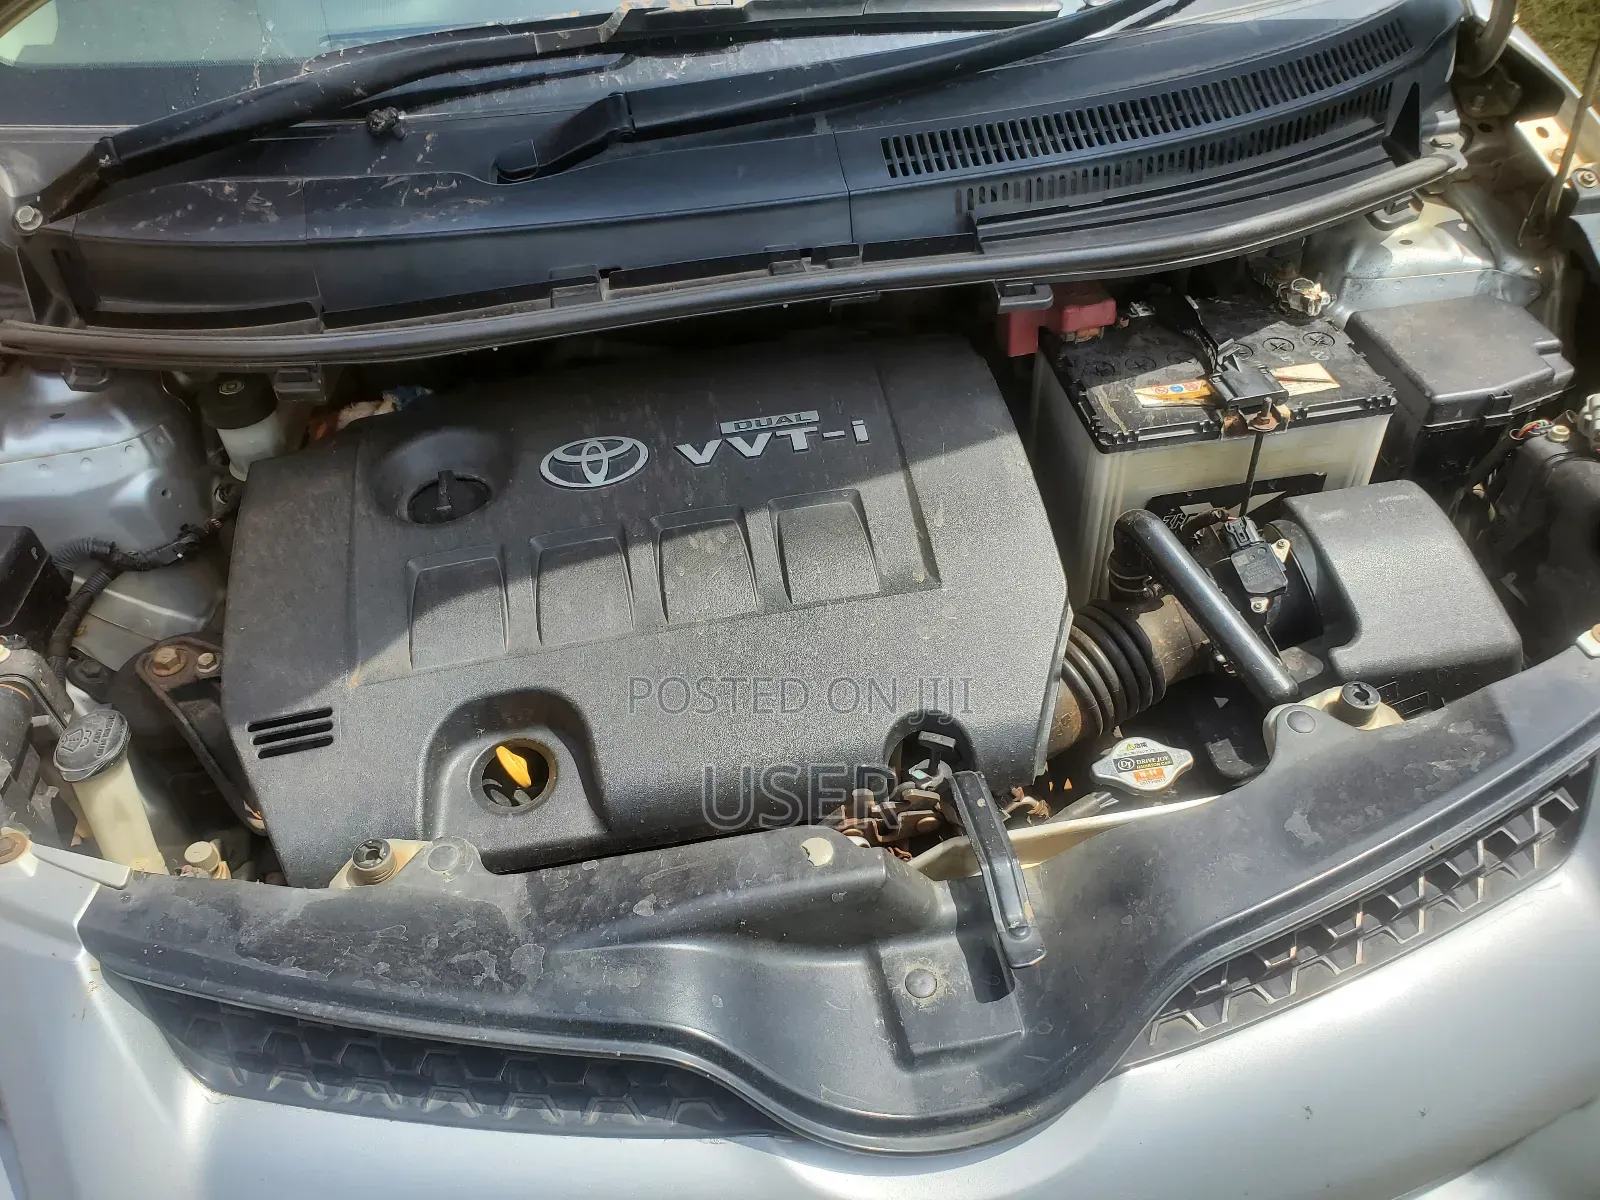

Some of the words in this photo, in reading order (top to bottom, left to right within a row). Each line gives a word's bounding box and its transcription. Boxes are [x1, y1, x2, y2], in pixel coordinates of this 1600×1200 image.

[731, 413, 812, 431] DUAL
[674, 419, 869, 465] VVT-i
[1136, 757, 1156, 765] DRIVE
